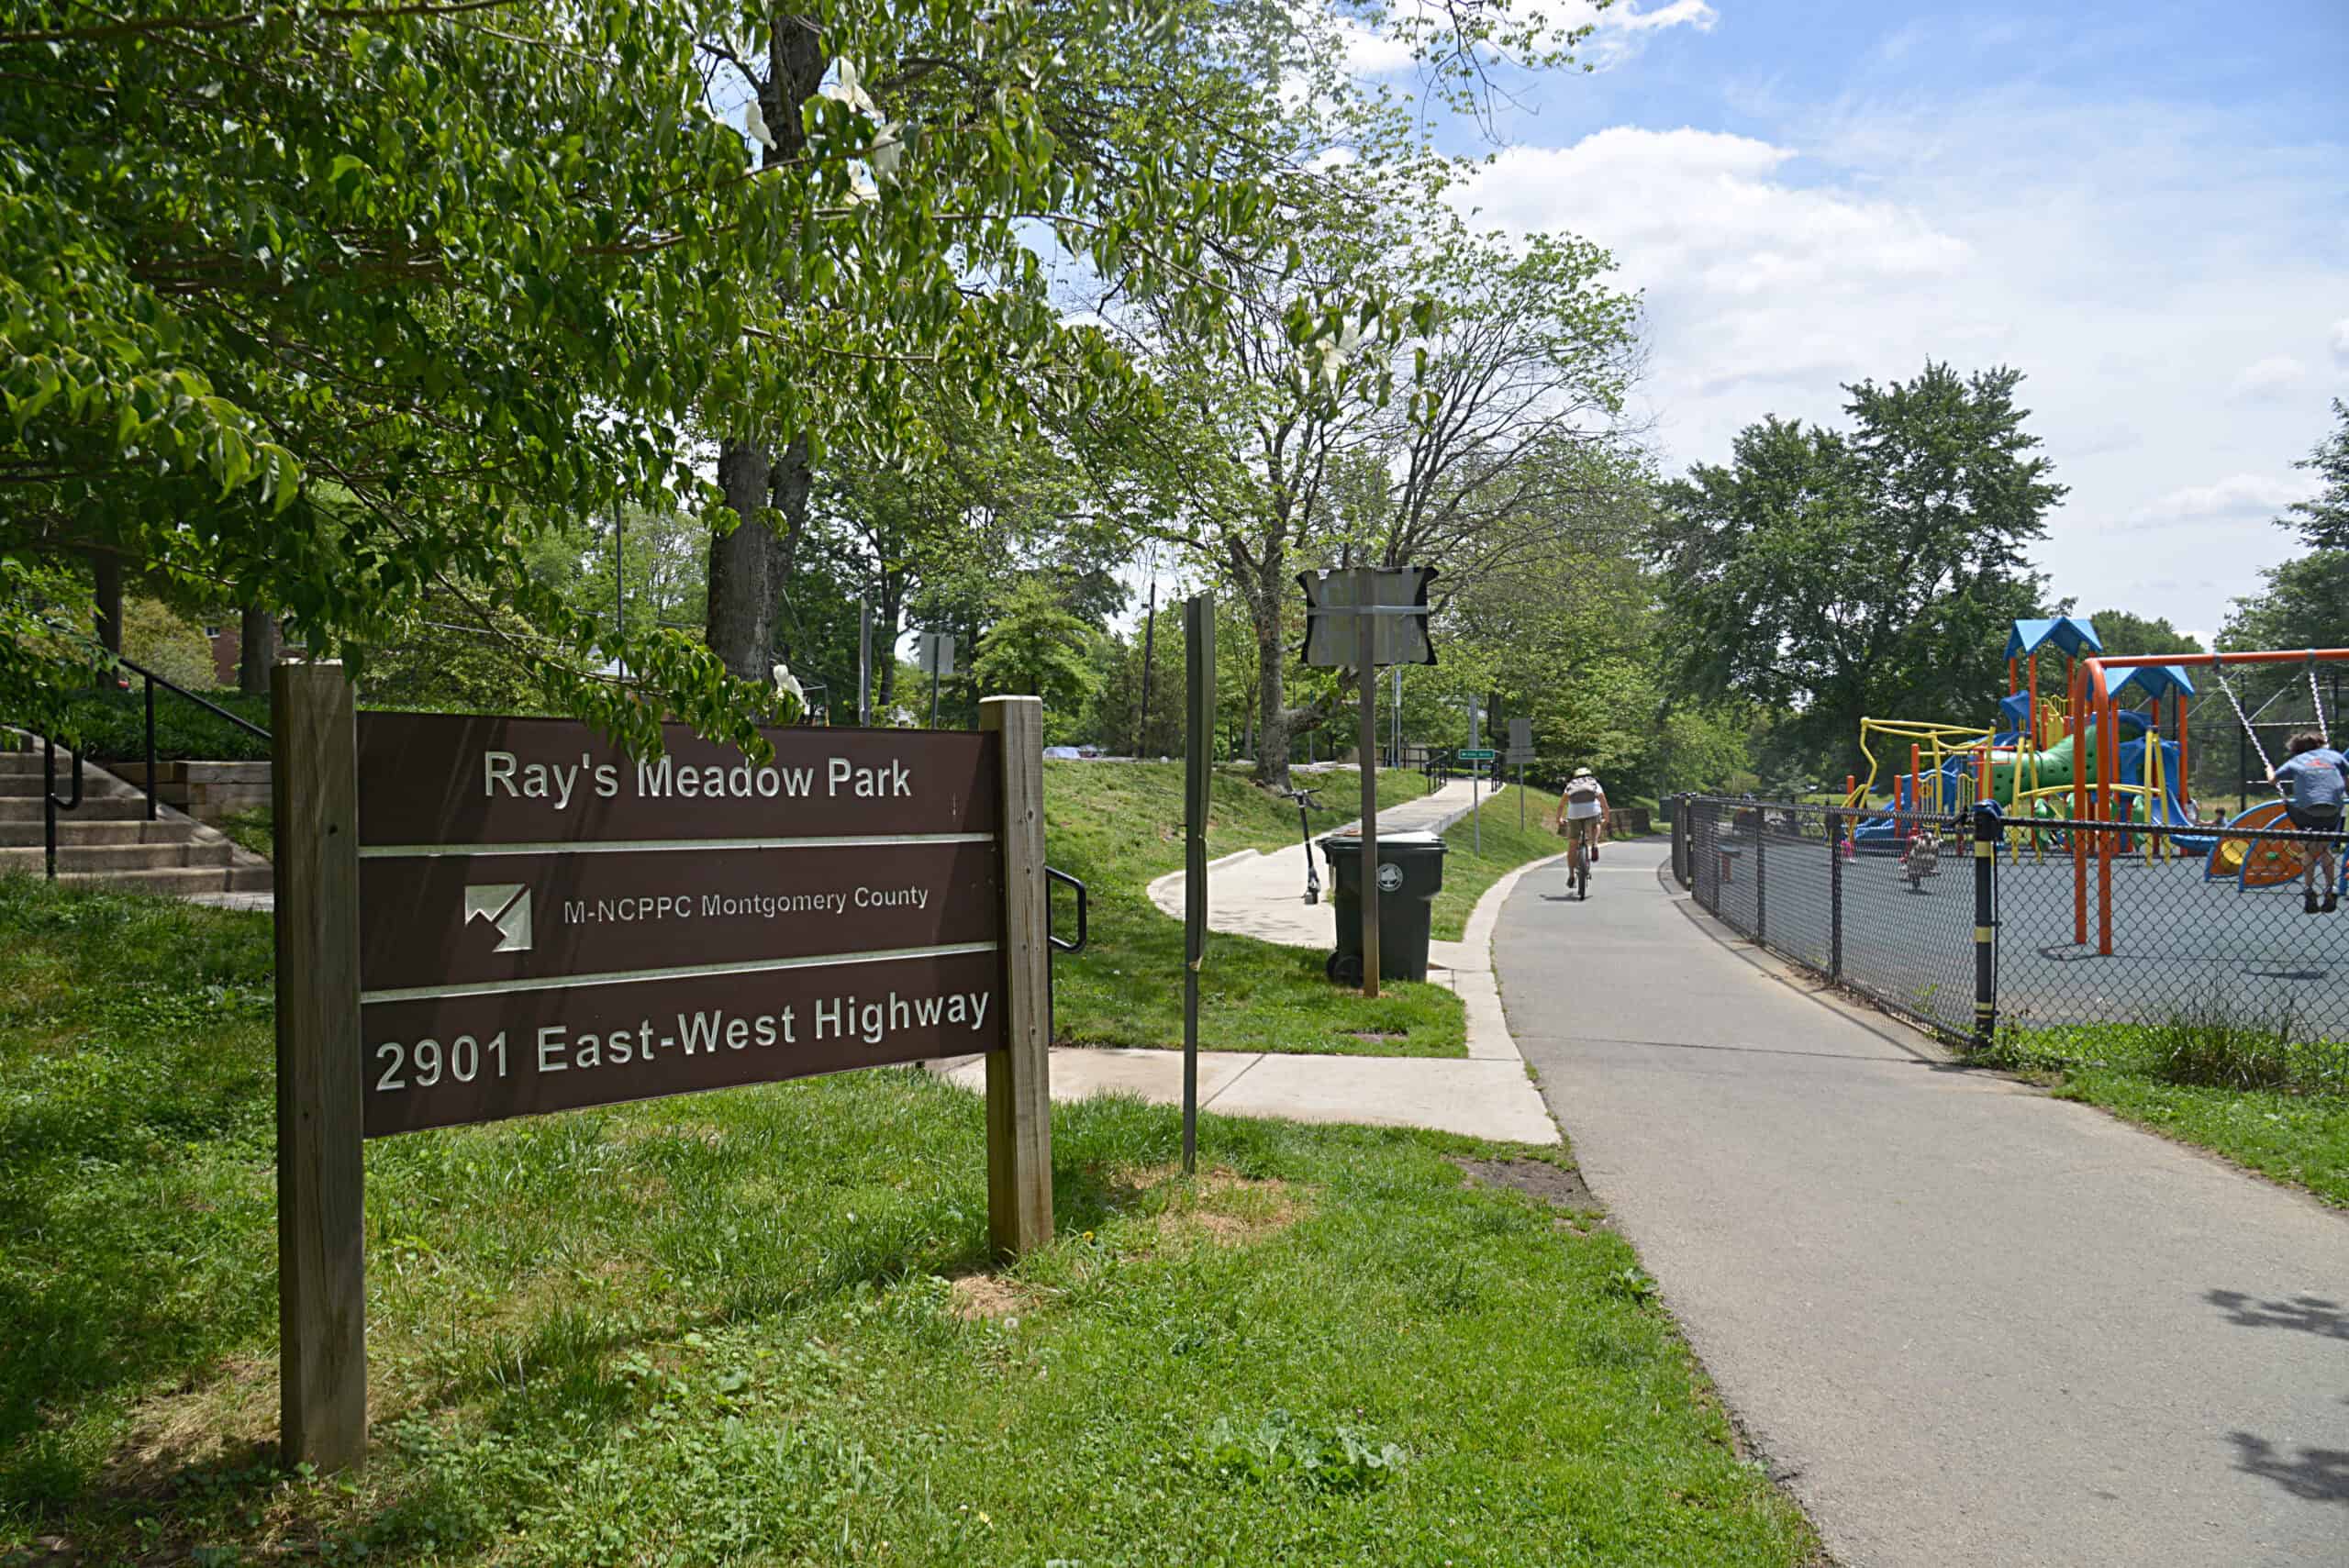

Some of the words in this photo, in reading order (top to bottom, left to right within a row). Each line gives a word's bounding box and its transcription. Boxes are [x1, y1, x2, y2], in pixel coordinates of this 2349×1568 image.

[484, 751, 618, 810] Ray's
[637, 753, 814, 798] Meadow
[828, 757, 913, 798] Park
[564, 895, 693, 924] M-NCPPC
[701, 892, 847, 918] Montgomery
[853, 884, 930, 910] County
[375, 1030, 507, 1092] 2901
[537, 1005, 796, 1073] East-West
[815, 991, 990, 1044] Highway
